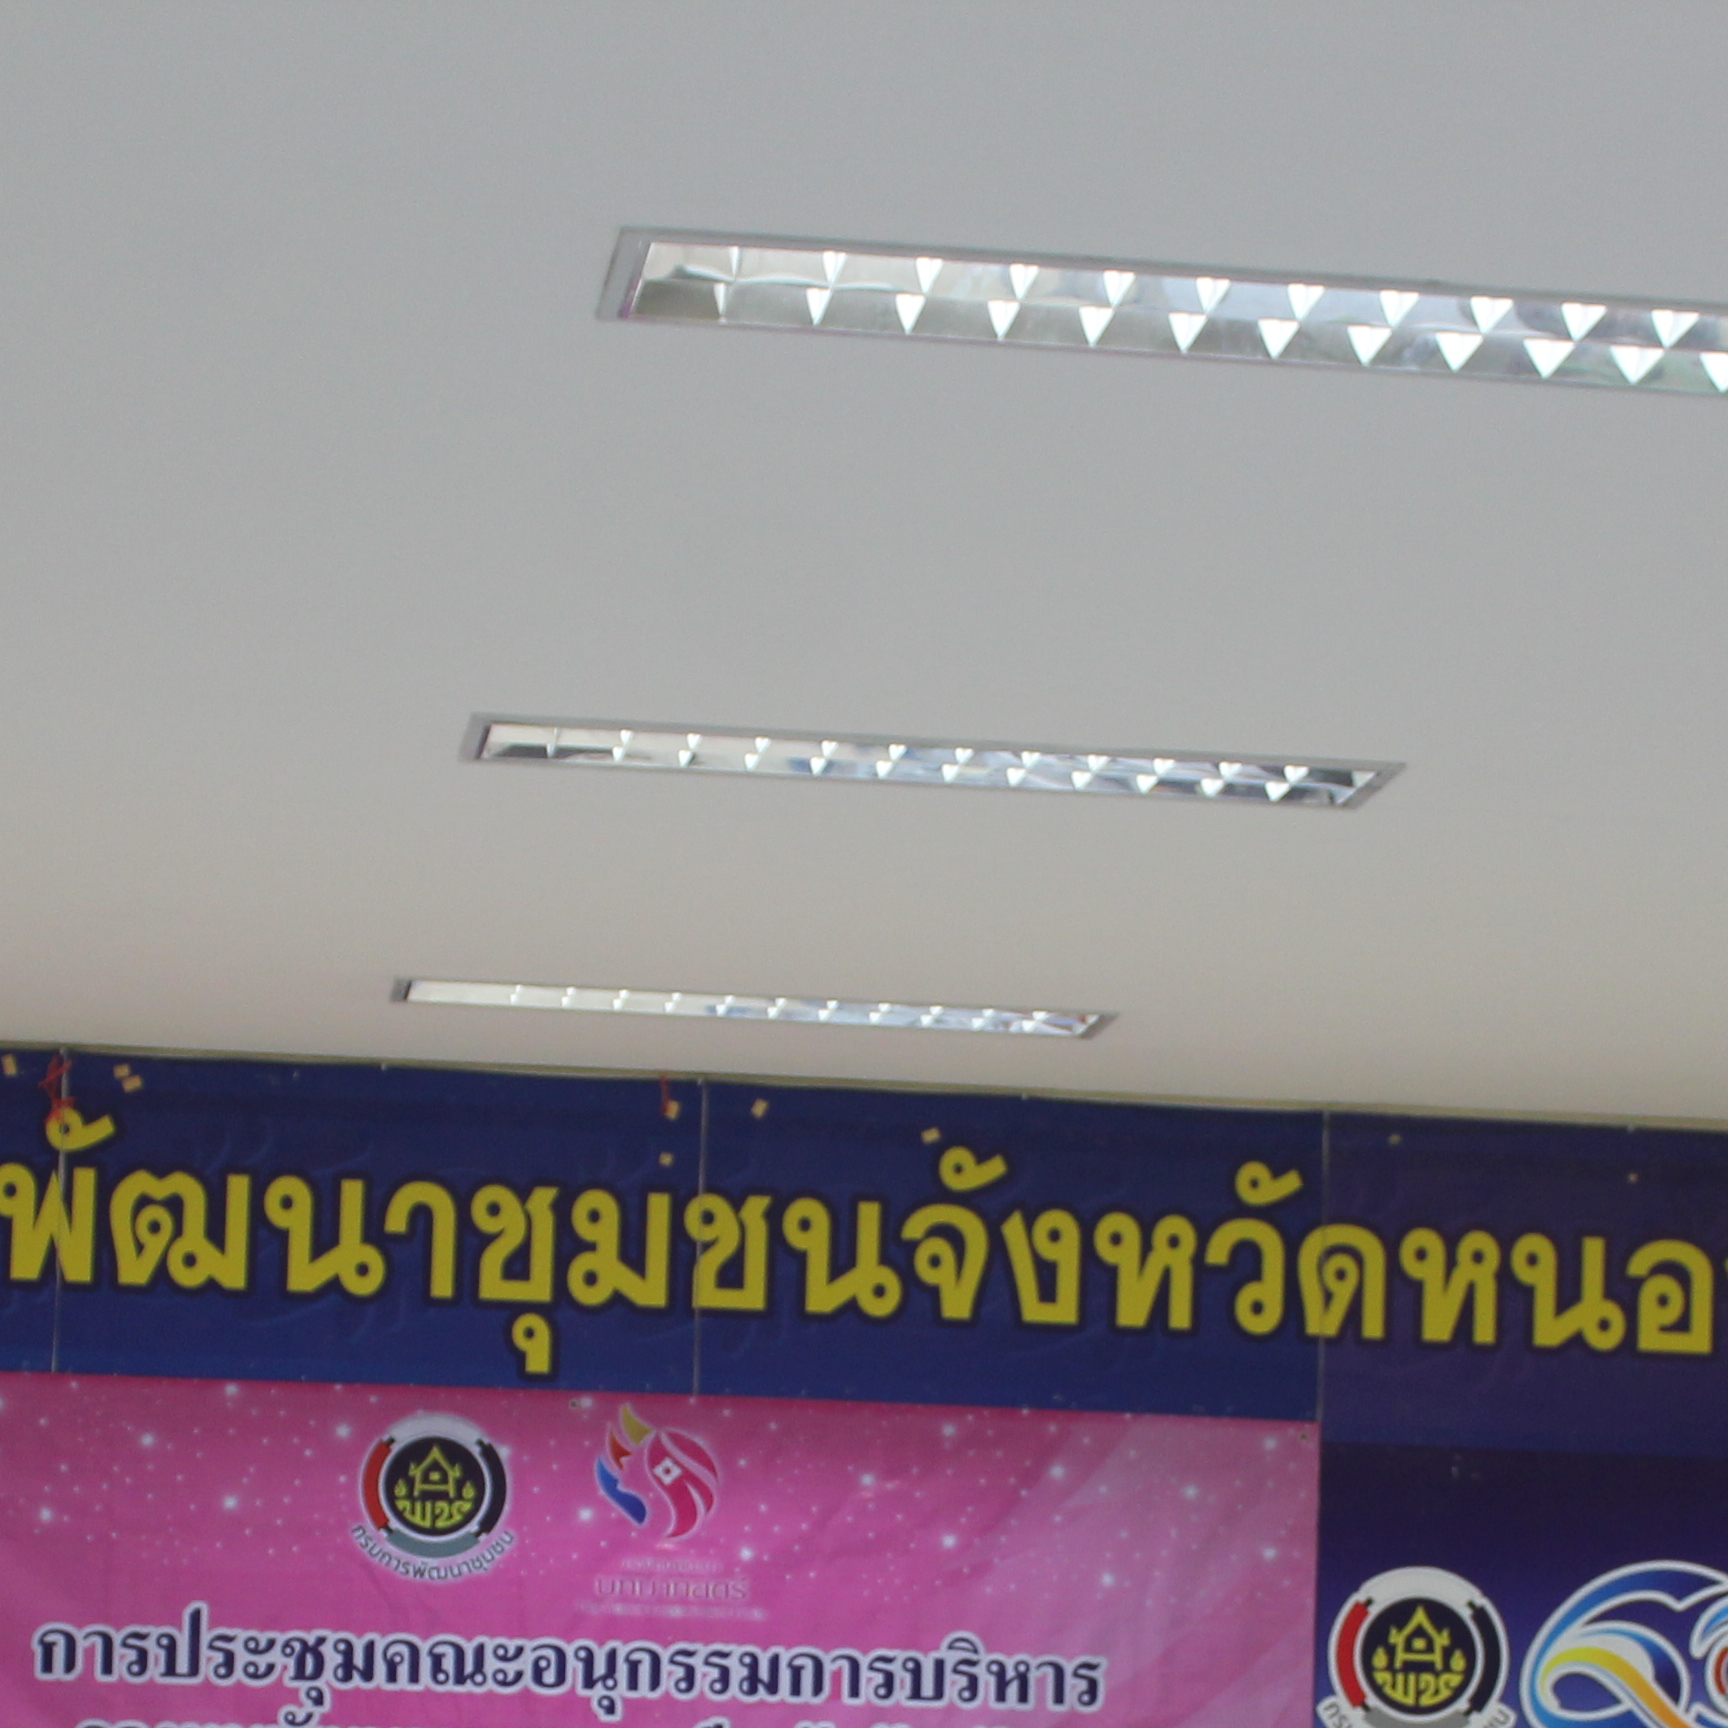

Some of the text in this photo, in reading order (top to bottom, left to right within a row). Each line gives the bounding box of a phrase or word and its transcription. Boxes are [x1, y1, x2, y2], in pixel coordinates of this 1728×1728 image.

[351, 1523, 516, 1581] กรมการพัฒนาชุมชน
[36, 1606, 1104, 1715] การประชุมคณะอนุกรรมการบริหาร
